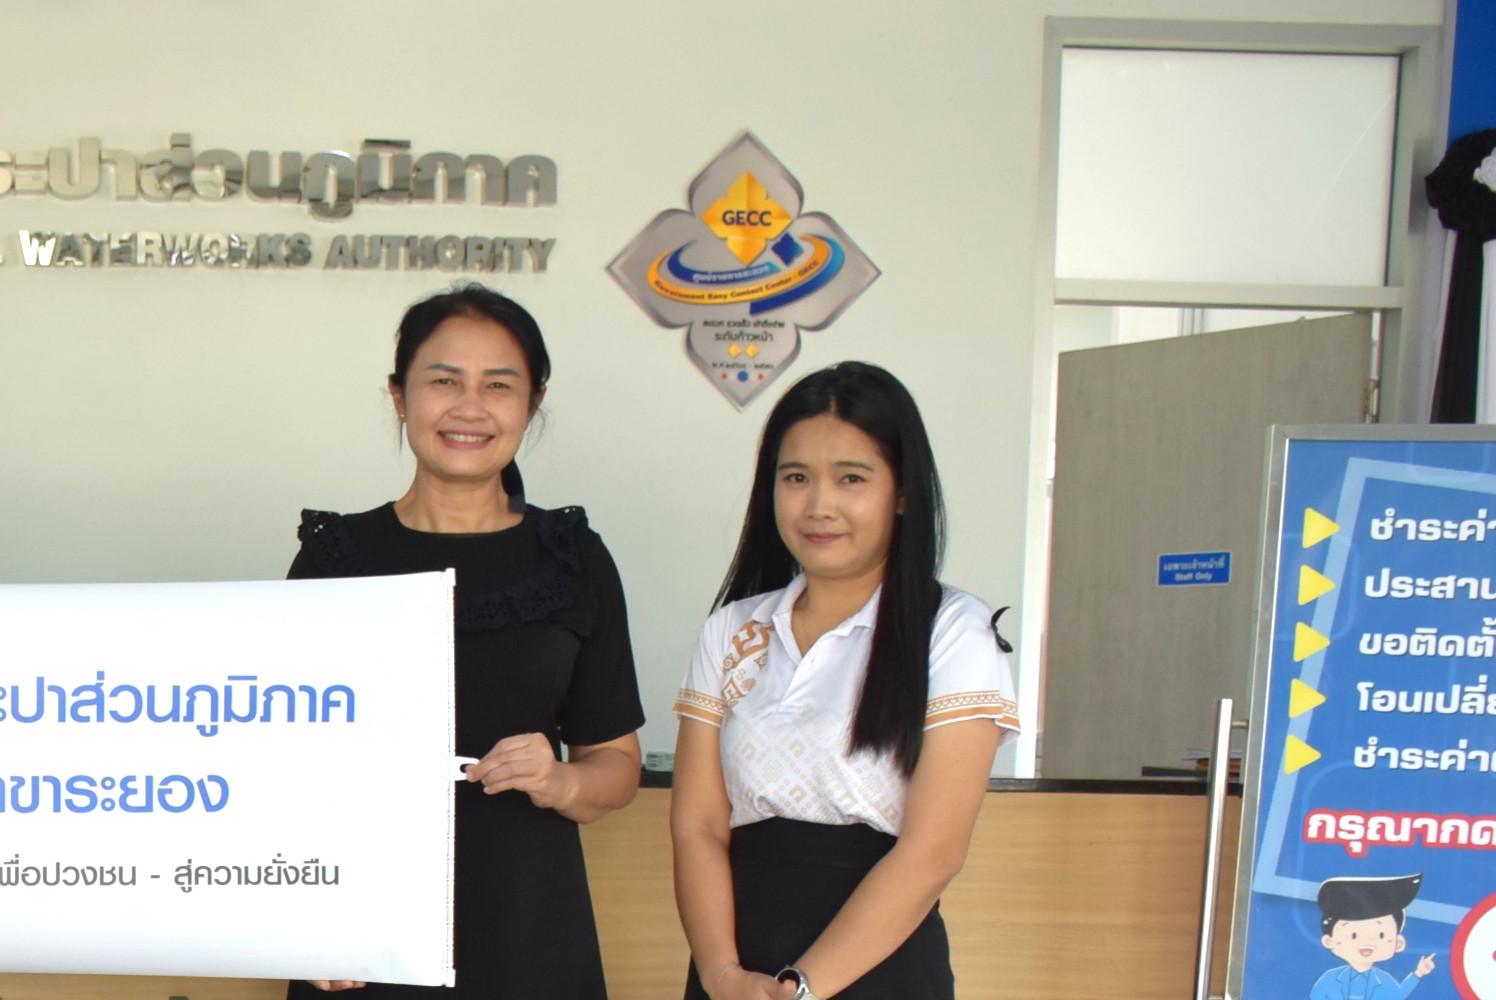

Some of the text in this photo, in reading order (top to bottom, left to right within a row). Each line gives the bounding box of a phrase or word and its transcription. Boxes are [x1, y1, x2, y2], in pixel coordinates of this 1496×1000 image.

[721, 210, 772, 226] GECC
[18, 229, 313, 269] WATERWORKS
[323, 233, 557, 273] AUTHORITY
[1194, 572, 1213, 582] Only
[1353, 737, 1496, 772] ชำระค่า
[1307, 812, 1496, 853] กรุณากด
[174, 853, 341, 893] สู่ความยั่งยืน
